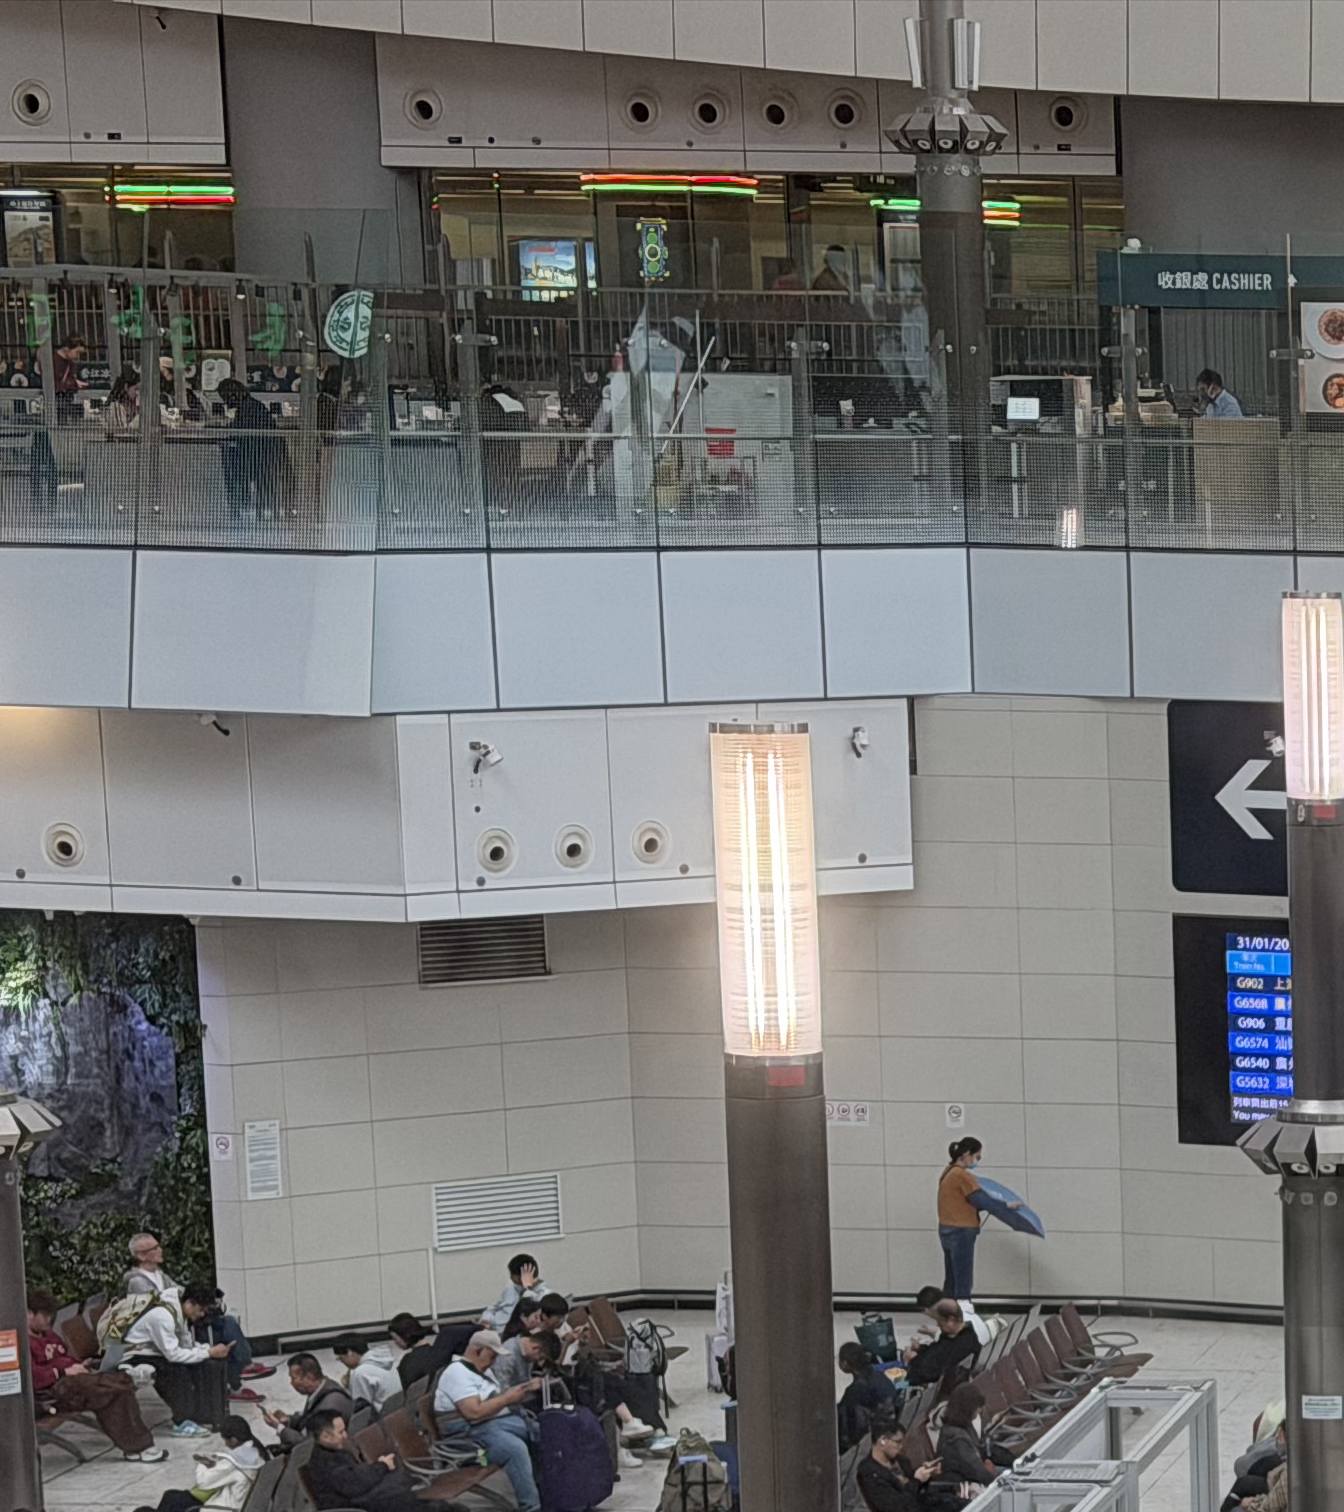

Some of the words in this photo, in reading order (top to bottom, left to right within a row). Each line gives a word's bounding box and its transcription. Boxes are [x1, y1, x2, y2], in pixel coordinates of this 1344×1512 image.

[1158, 271, 1208, 289] 收銀處
[1212, 273, 1272, 290] CASHIER
[1237, 936, 1291, 950] 31/01/20
[1236, 976, 1264, 990] G902
[1238, 1016, 1265, 1029] G906
[1236, 1036, 1269, 1049] G6574
[1236, 1056, 1270, 1069] G6540
[1236, 1076, 1270, 1089] G5632
[1233, 1110, 1251, 1121] You
